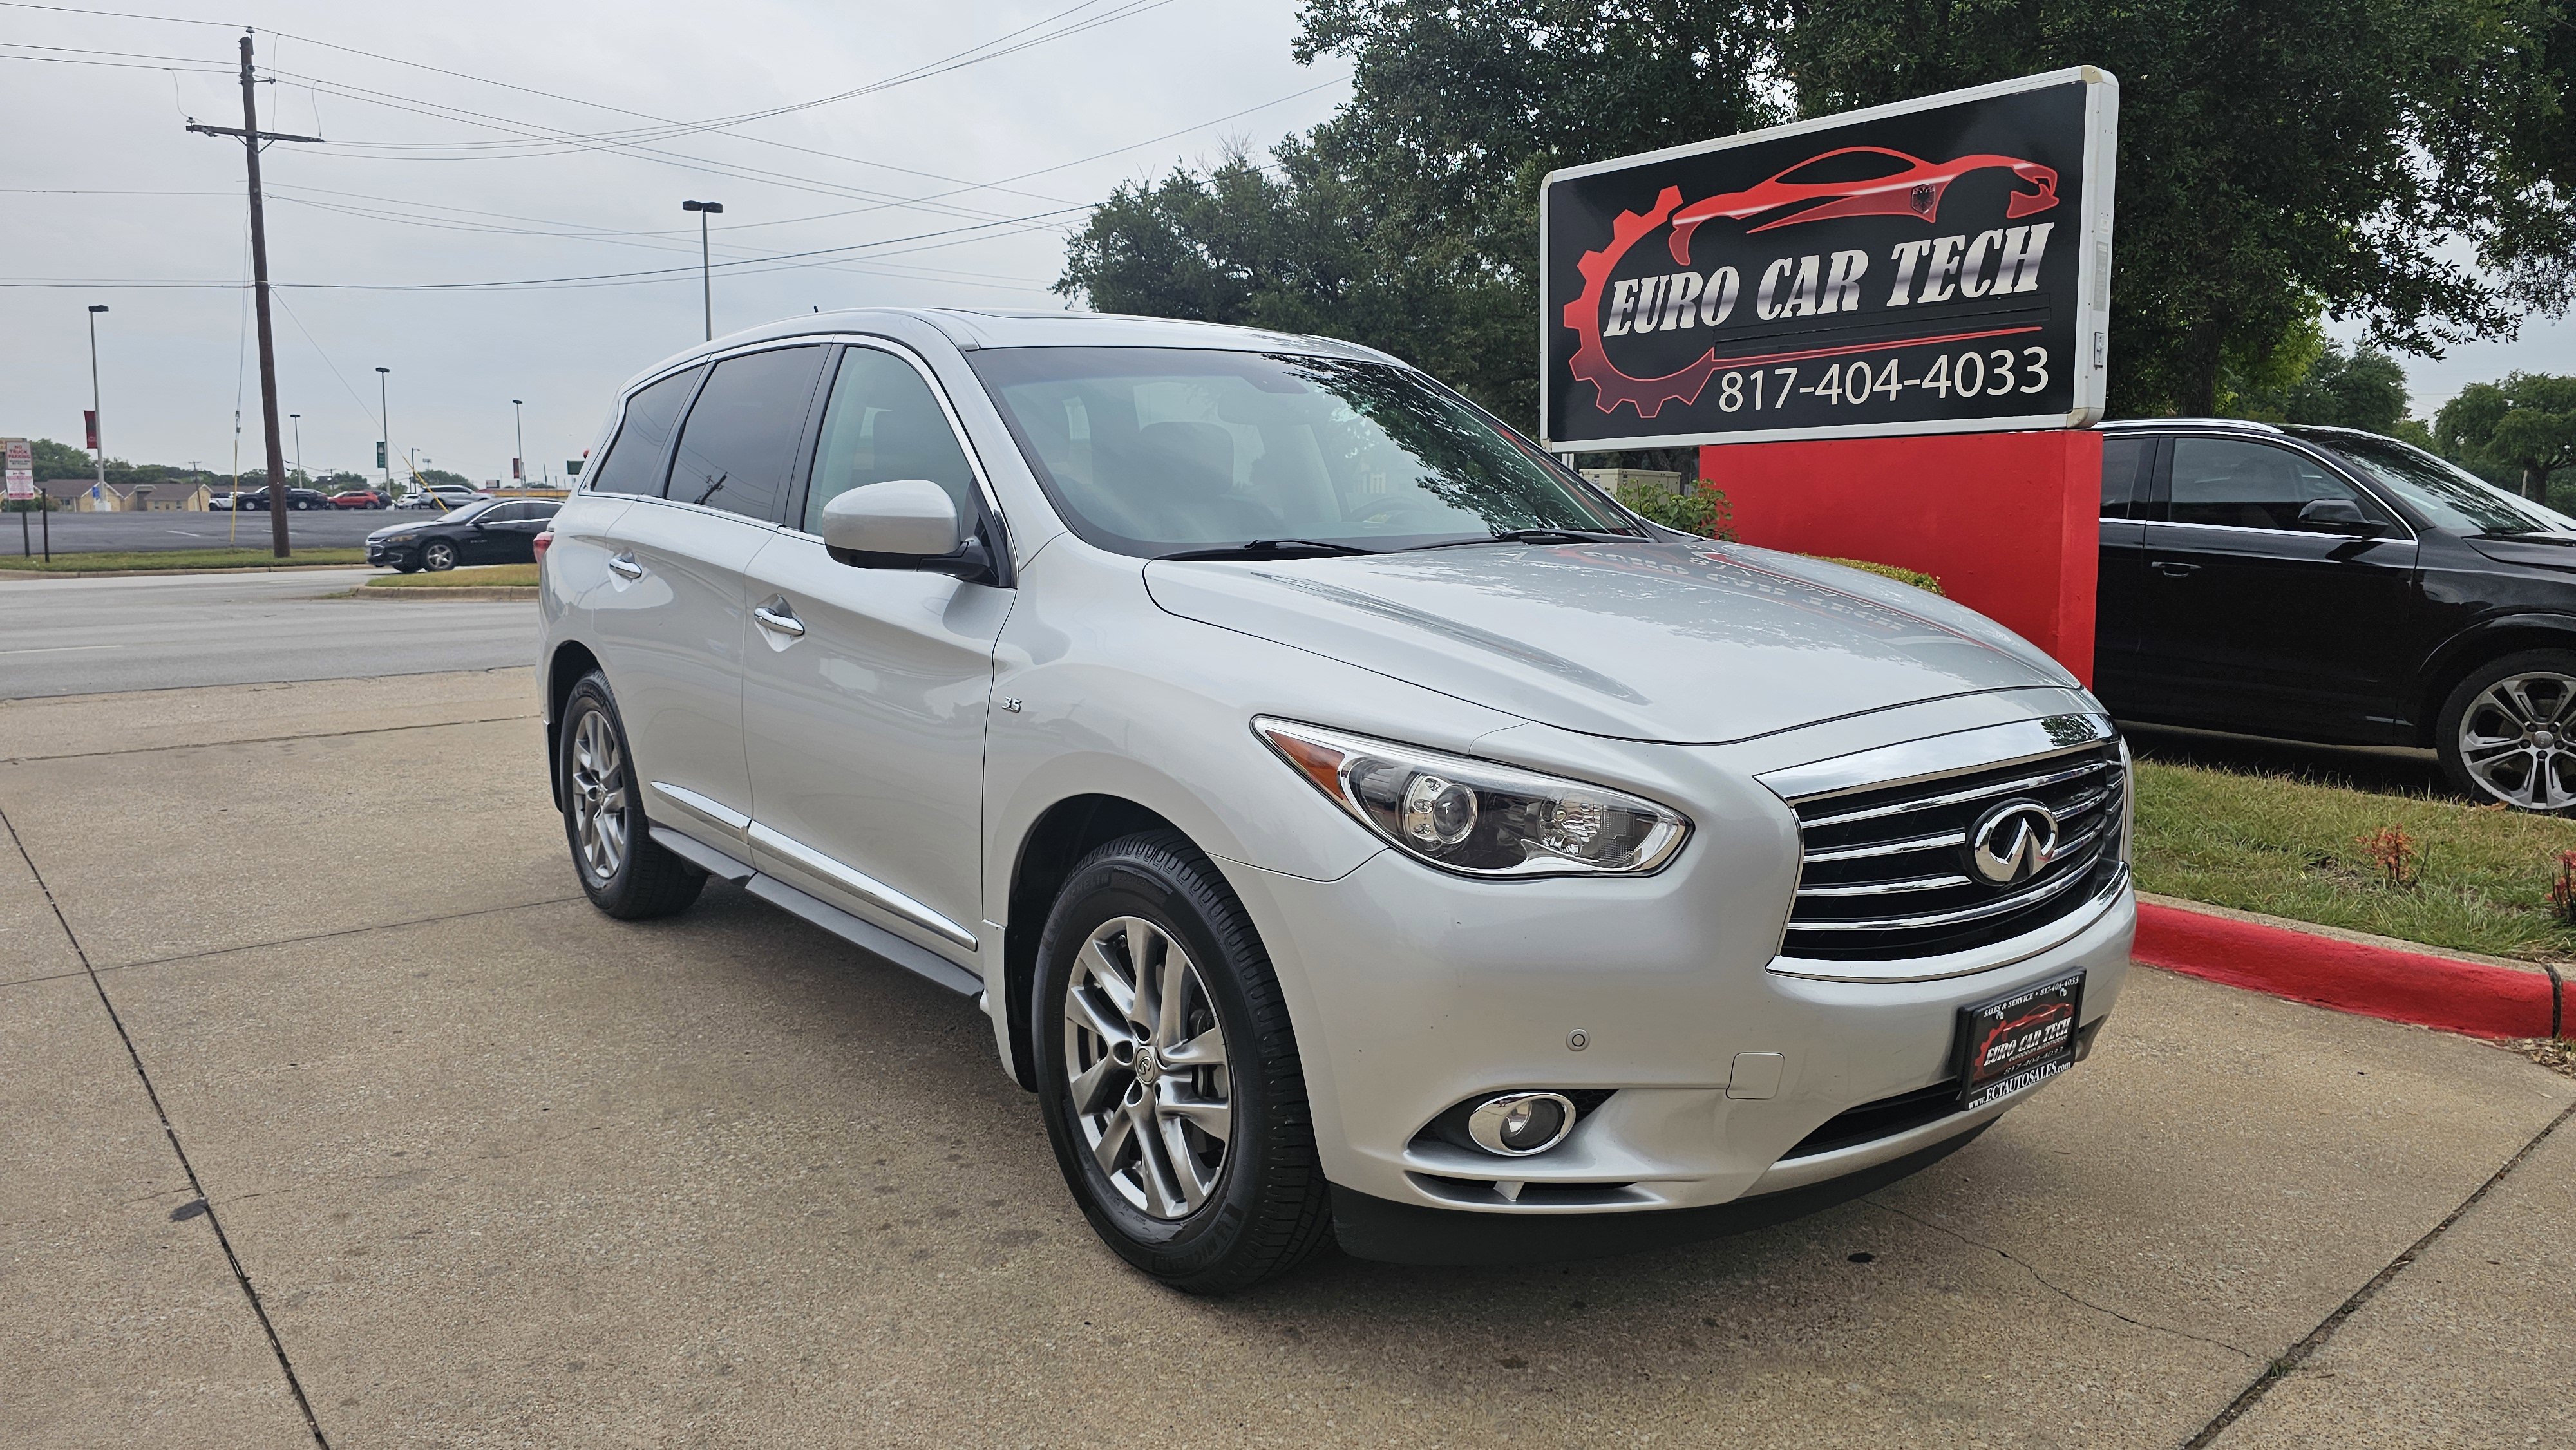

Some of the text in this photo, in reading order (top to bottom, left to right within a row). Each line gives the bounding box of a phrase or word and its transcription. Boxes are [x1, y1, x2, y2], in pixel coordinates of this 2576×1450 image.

[1603, 265, 1740, 338] EURO
[1756, 248, 1868, 320] CAR
[1886, 221, 2055, 307] TECH
[1718, 346, 2050, 413] 817-404-4033
[1002, 696, 1022, 713] 35
[1984, 1004, 2001, 1017] SALES
[2007, 992, 2034, 1008] SERVICE
[1984, 1017, 2072, 1066] EURO CAR TECH
[2003, 1046, 2063, 1075] 817-404-4033
[2009, 1034, 2068, 1062] european automotive
[1968, 1060, 2071, 1109] www.ECTAUTOSALES.com
